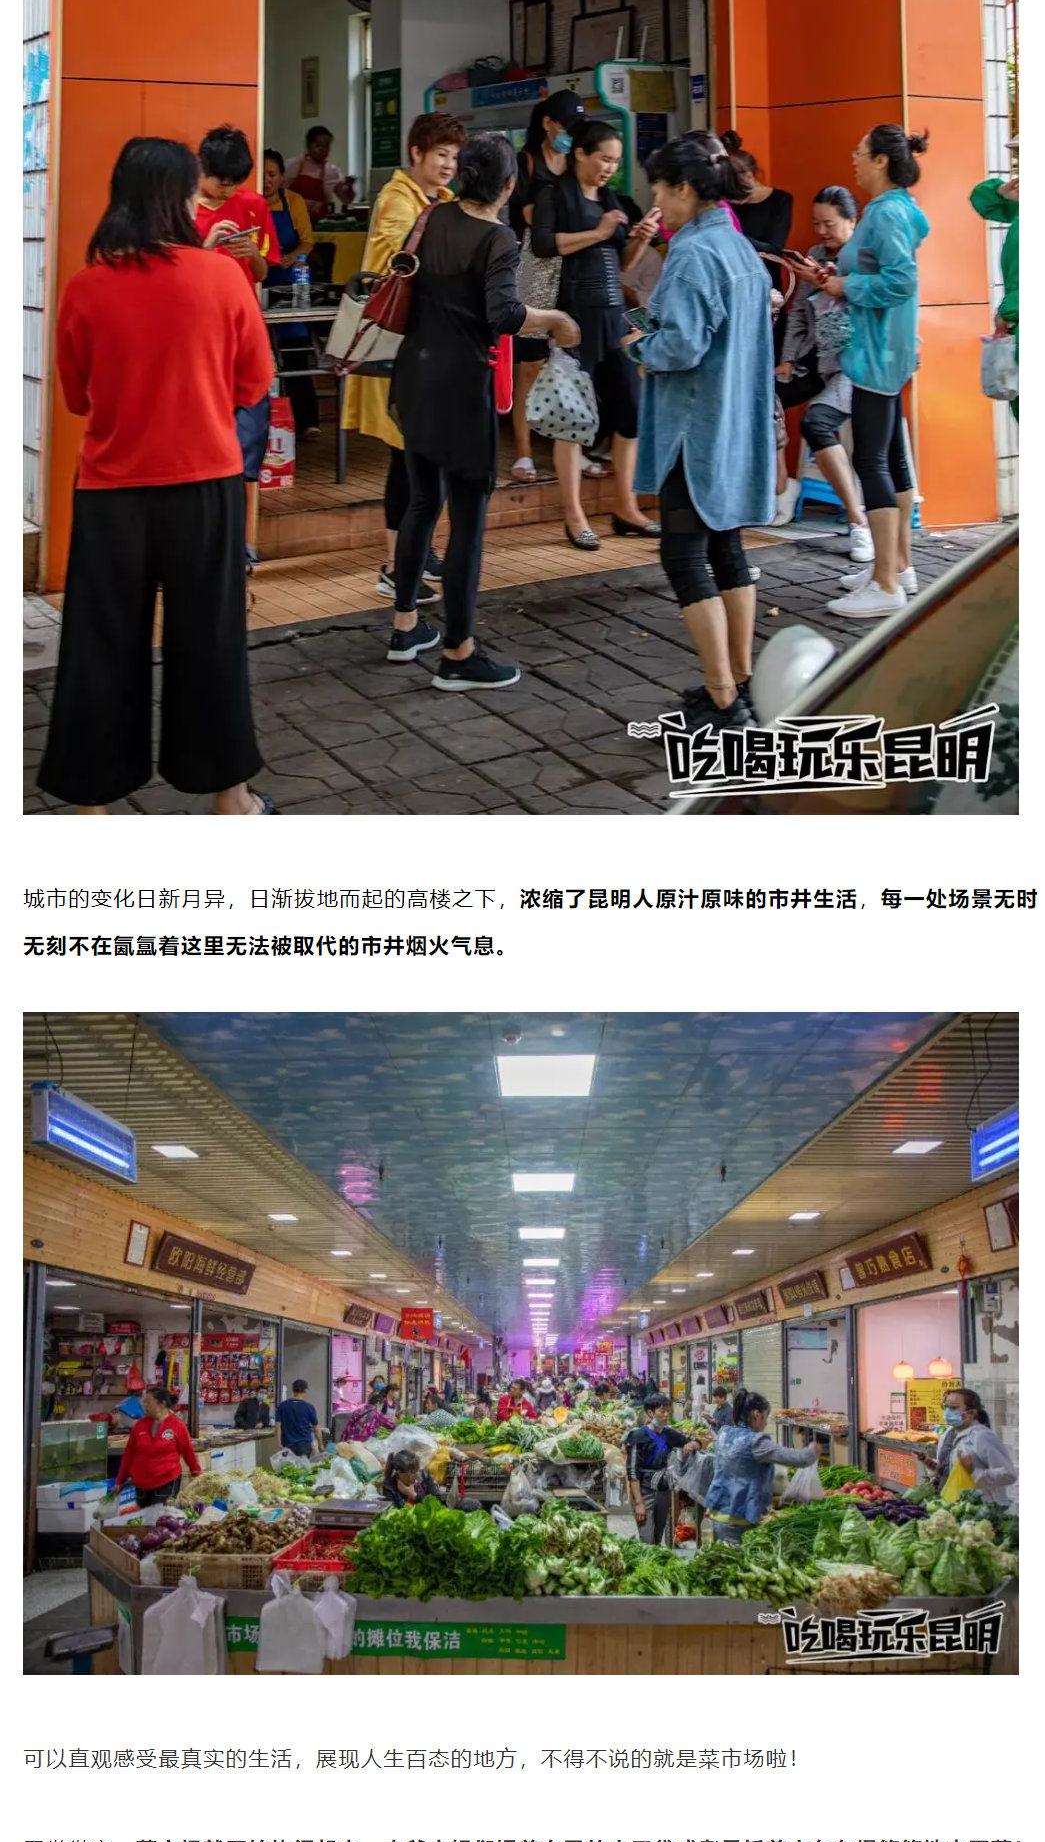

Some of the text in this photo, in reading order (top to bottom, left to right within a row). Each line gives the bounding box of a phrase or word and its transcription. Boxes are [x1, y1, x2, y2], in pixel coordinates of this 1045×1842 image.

[24, 887, 1038, 910] 城市的变化日新月异，日渐拔地而起的高楼之下，浓缩了昆明人原汁原味的市井生活，每一处场景无时
[24, 934, 504, 957] 无刻不在氤氲着这里无法被取代的市井烟火气息。
[24, 1746, 796, 1770] 可以直观感受最真实的生活，展现人生百态的地方，不得不说的就是菜市场啦！
